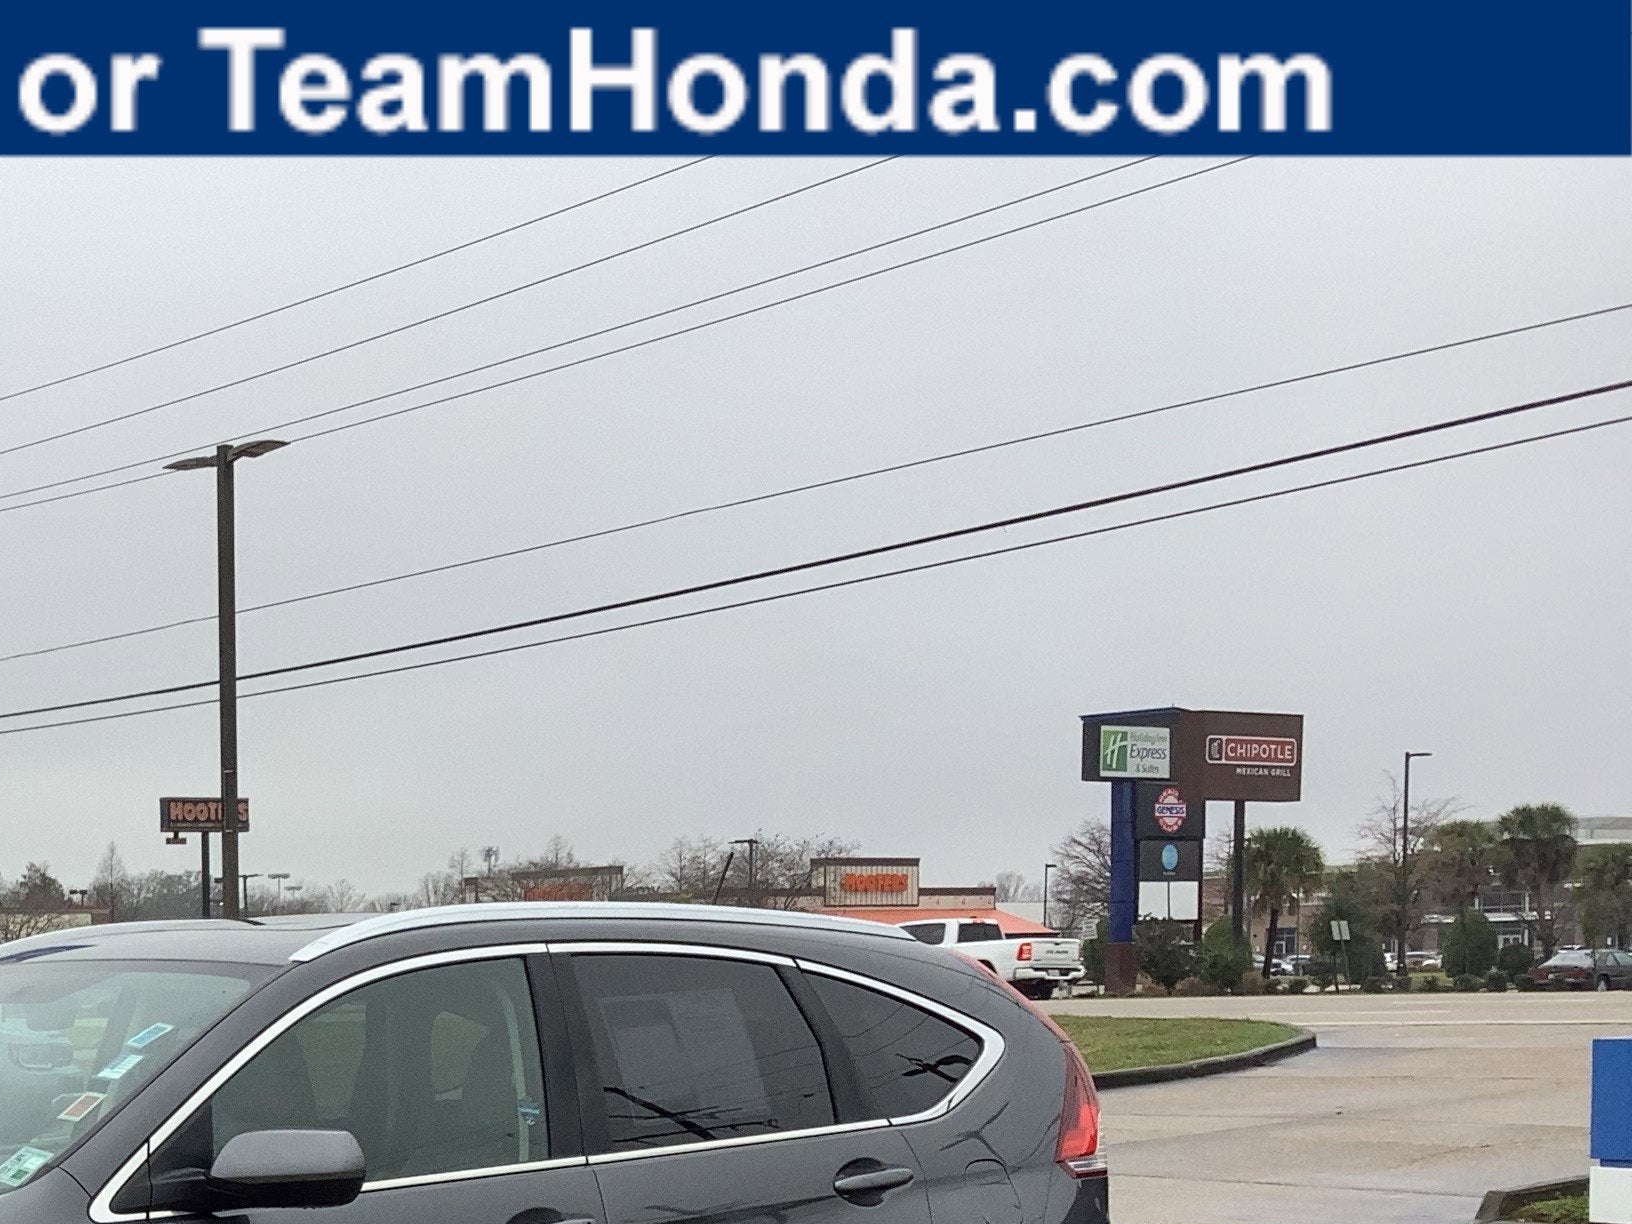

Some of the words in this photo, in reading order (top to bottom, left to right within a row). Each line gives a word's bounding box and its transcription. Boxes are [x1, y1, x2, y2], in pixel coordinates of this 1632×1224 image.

[1130, 743, 1167, 761] Express
[1227, 743, 1293, 759] CHIPOTLE
[1236, 767, 1269, 776] MEXICAN
[1270, 768, 1291, 777] GRILL
[169, 801, 248, 821] HOOTS
